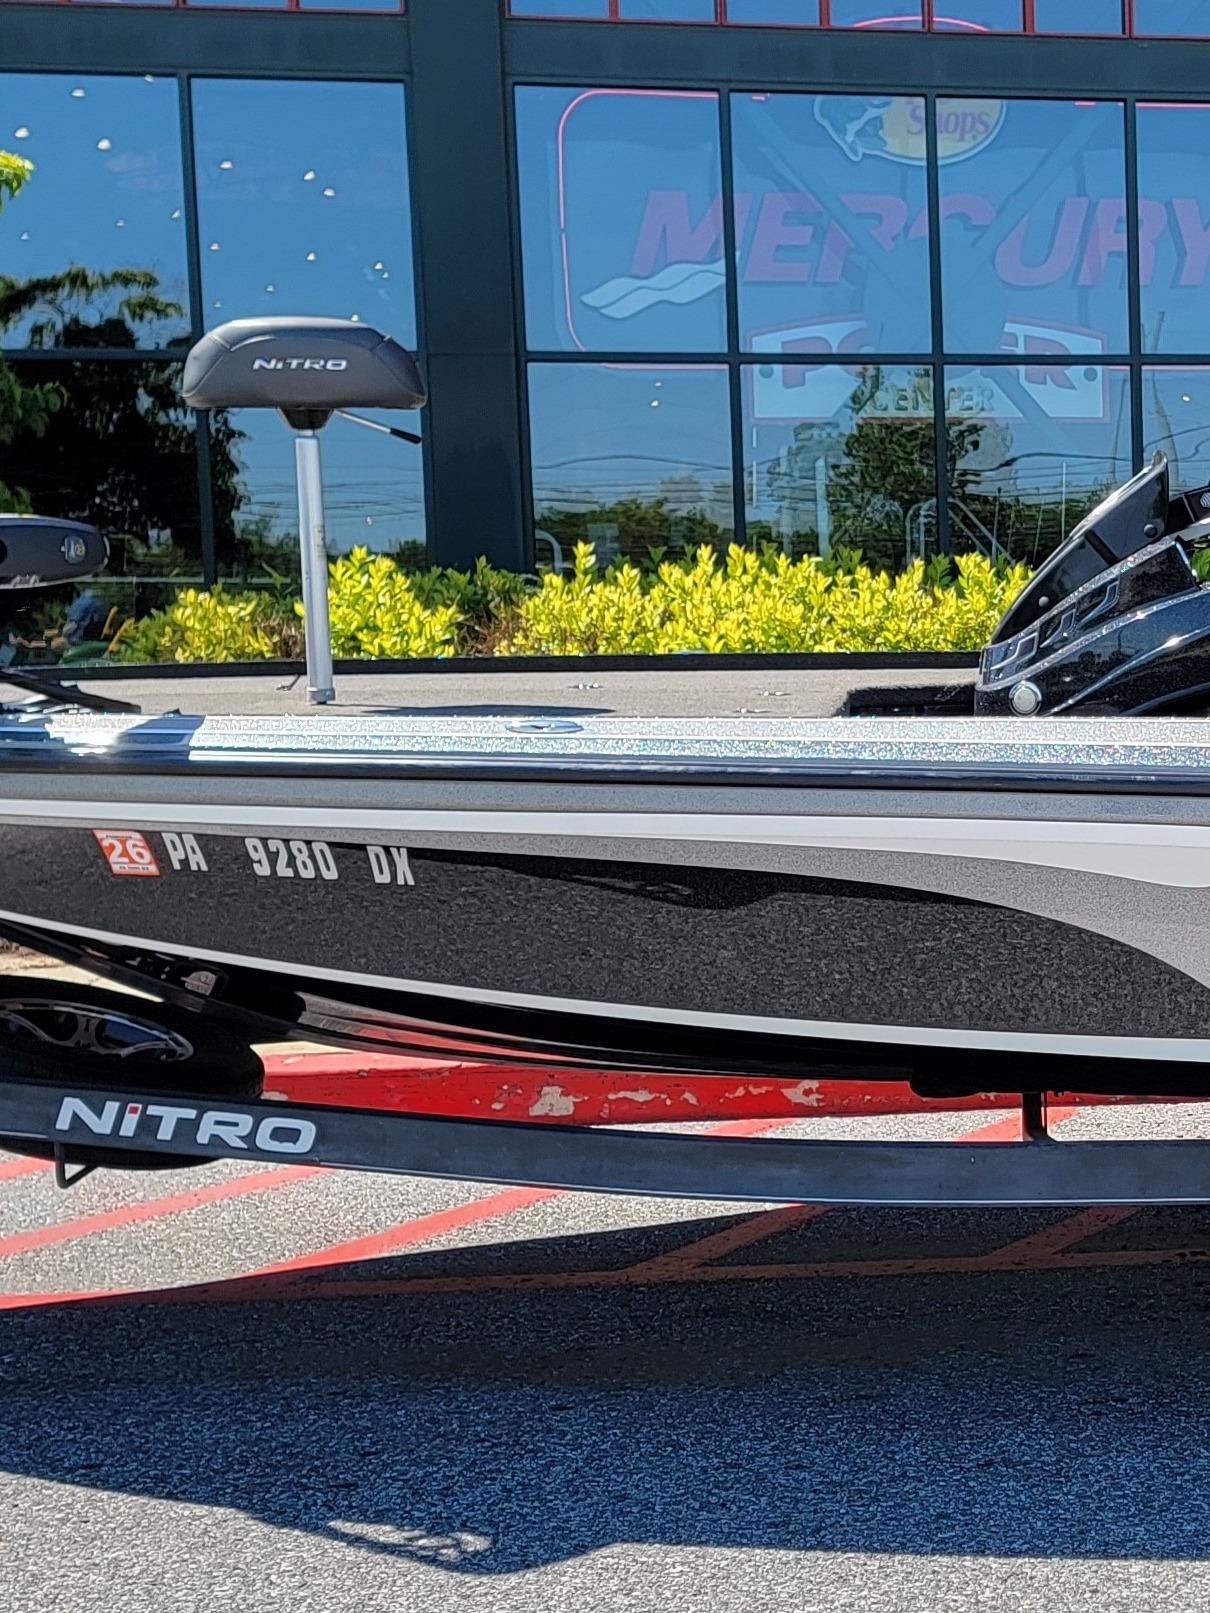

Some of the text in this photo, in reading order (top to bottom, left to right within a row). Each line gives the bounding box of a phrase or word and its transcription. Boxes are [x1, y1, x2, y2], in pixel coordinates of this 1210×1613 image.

[906, 105, 991, 142] Sops
[251, 357, 349, 372] NITRO
[781, 328, 1077, 390] POR
[102, 838, 150, 864] 26
[160, 832, 416, 886] PA 9280 DX
[55, 1096, 317, 1154] NITRO
